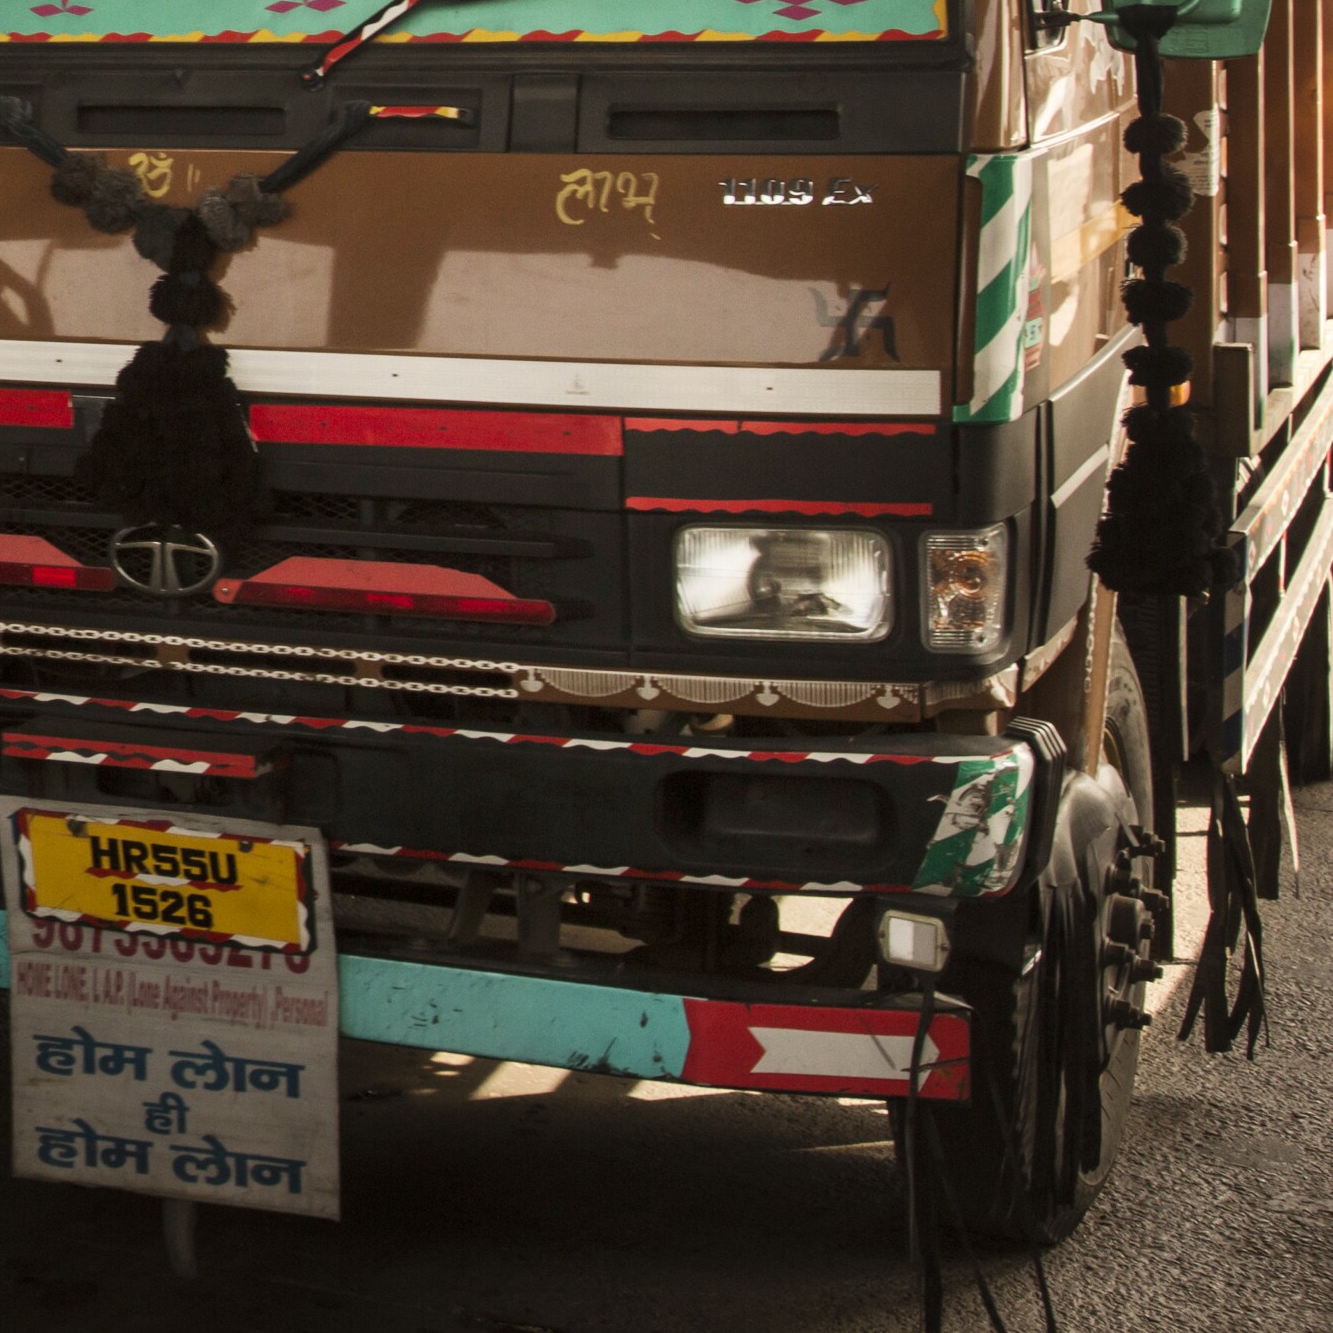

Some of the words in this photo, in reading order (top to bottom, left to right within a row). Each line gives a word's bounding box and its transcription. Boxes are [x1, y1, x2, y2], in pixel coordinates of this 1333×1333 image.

[90, 835, 238, 885] HR55U
[111, 883, 214, 929] 1526
[16, 961, 53, 998] HOME
[162, 974, 209, 1021] Against
[33, 1026, 153, 1082] होम
[142, 1092, 190, 1135] ही
[35, 1118, 154, 1175] होम
